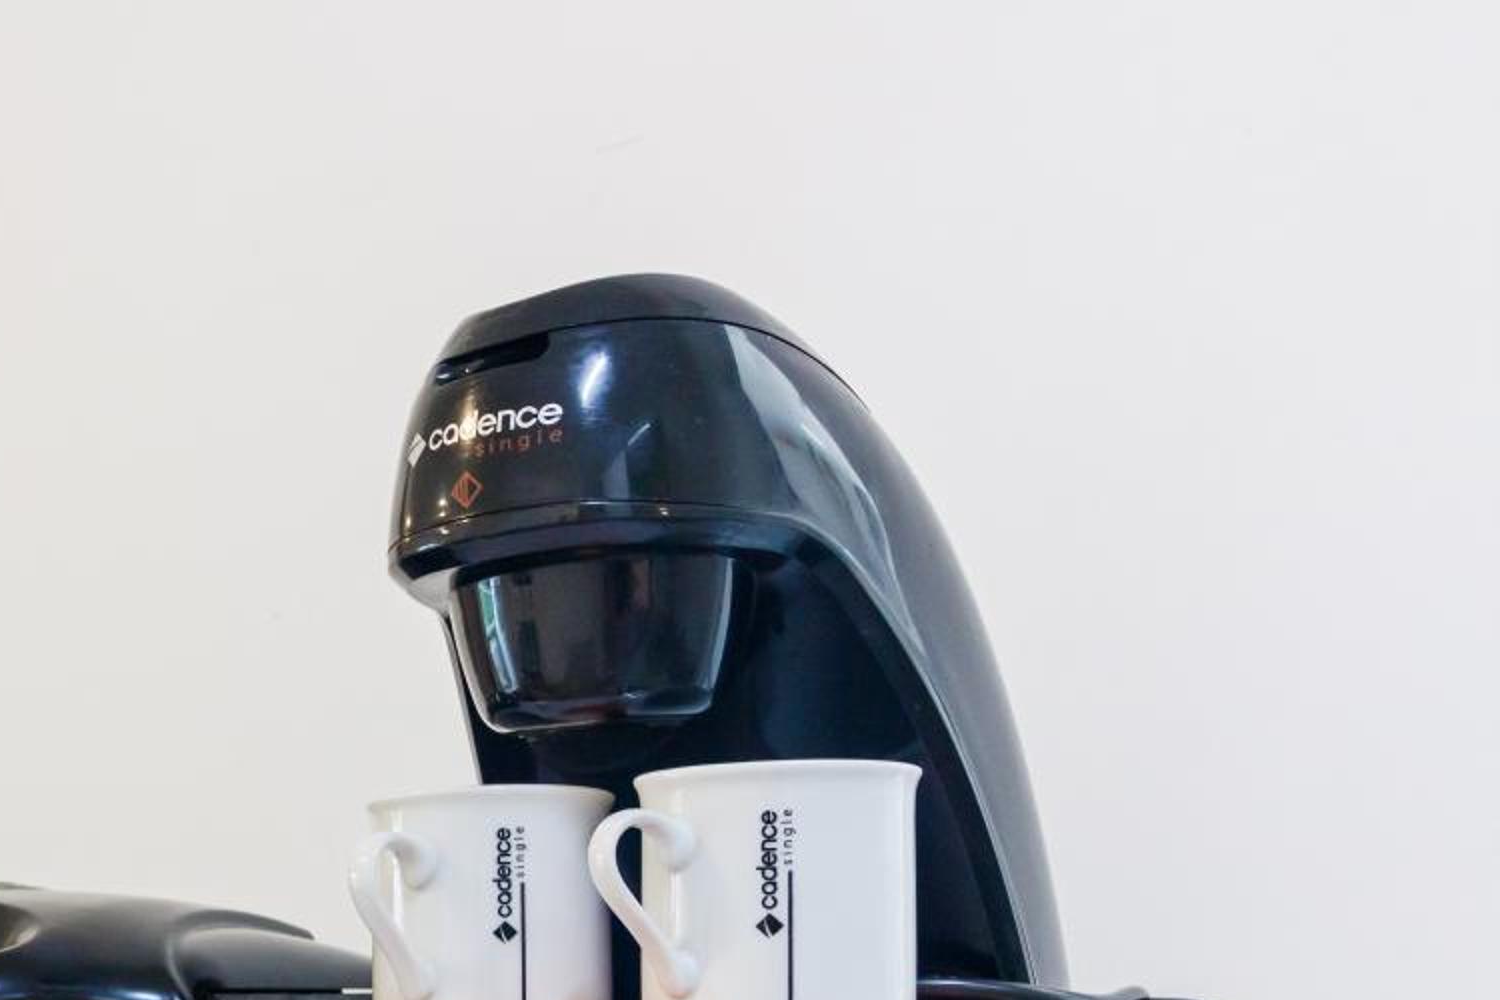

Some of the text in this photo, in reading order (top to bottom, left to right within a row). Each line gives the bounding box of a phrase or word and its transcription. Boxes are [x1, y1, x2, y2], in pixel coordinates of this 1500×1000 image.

[429, 402, 564, 450] cadence
[476, 428, 564, 459] single
[514, 826, 527, 879] single
[755, 809, 779, 910] cadence
[780, 809, 797, 865] single
[491, 827, 513, 918] cadence
